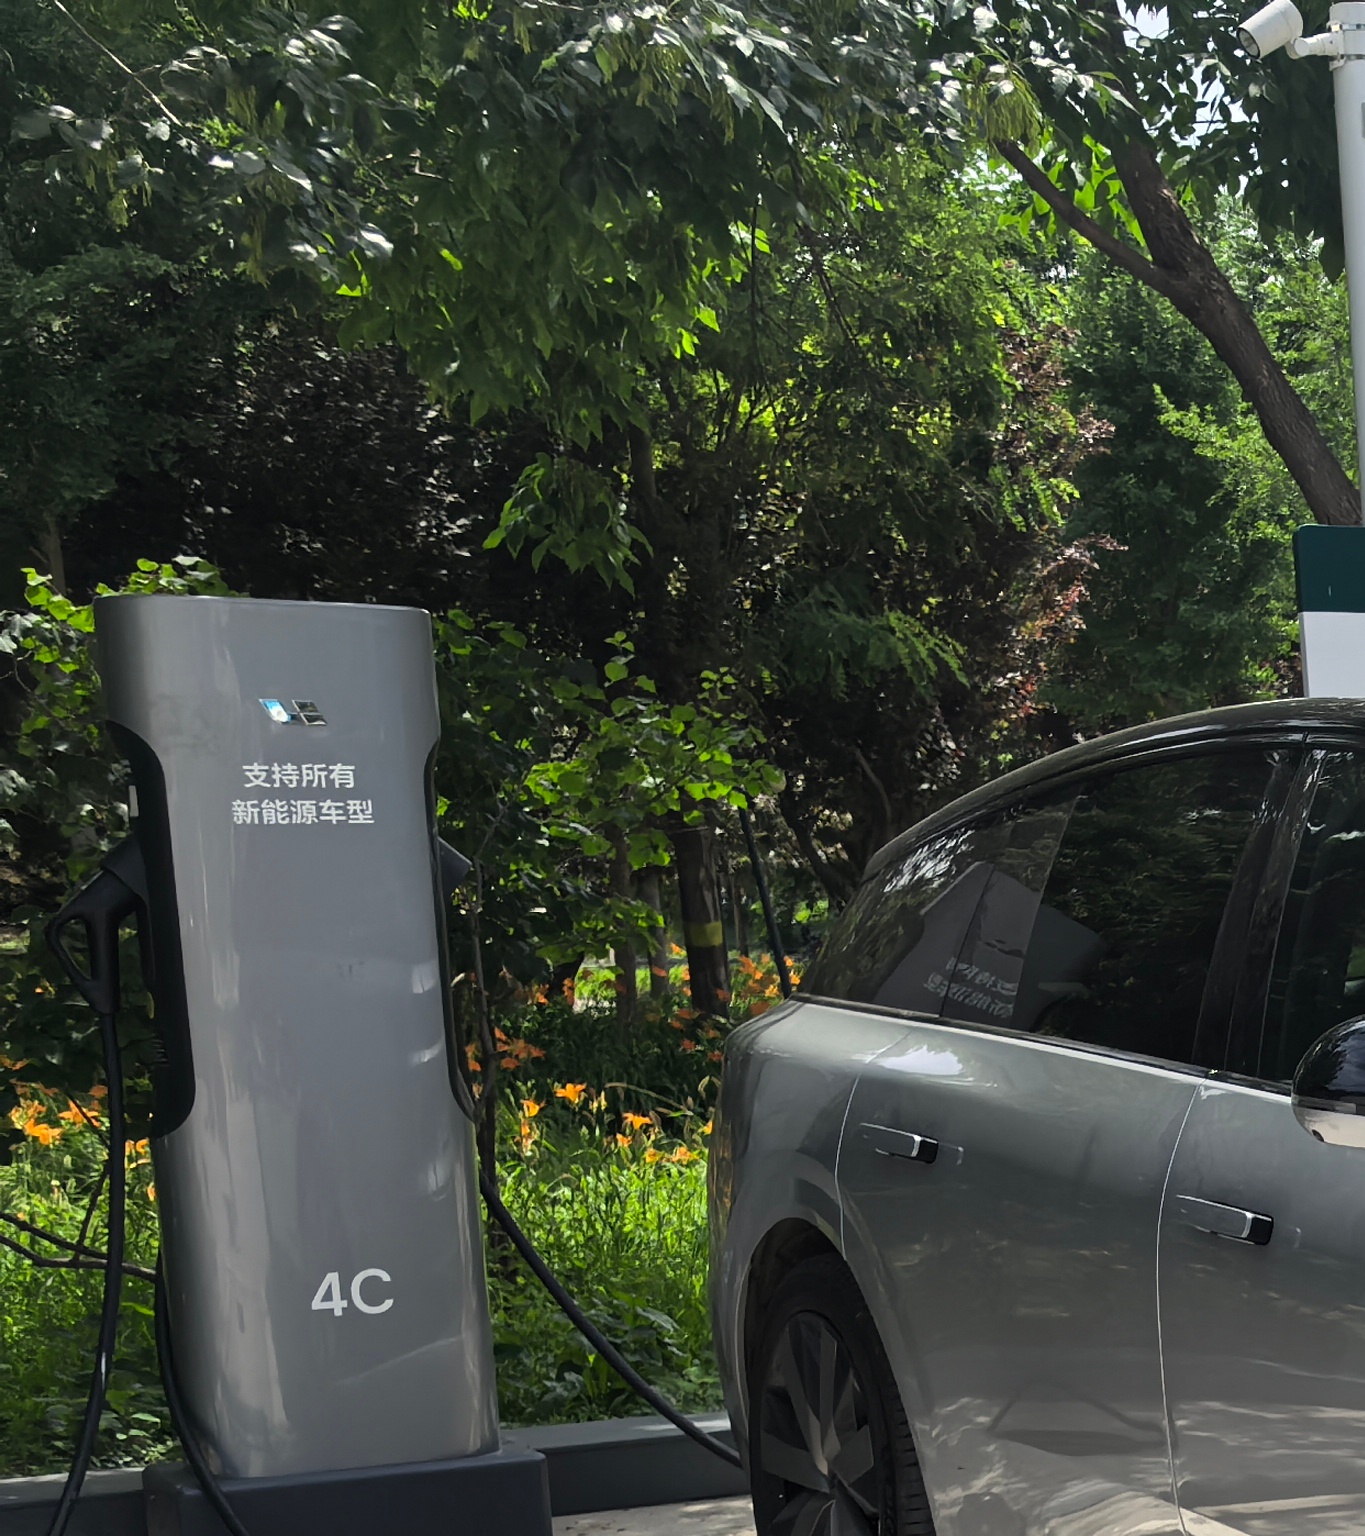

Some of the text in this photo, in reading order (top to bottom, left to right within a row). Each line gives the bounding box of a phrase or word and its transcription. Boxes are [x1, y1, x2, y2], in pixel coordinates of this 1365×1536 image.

[242, 762, 356, 788] 支持所有
[231, 799, 375, 825] 新能源车型
[311, 1268, 395, 1317] 4C
